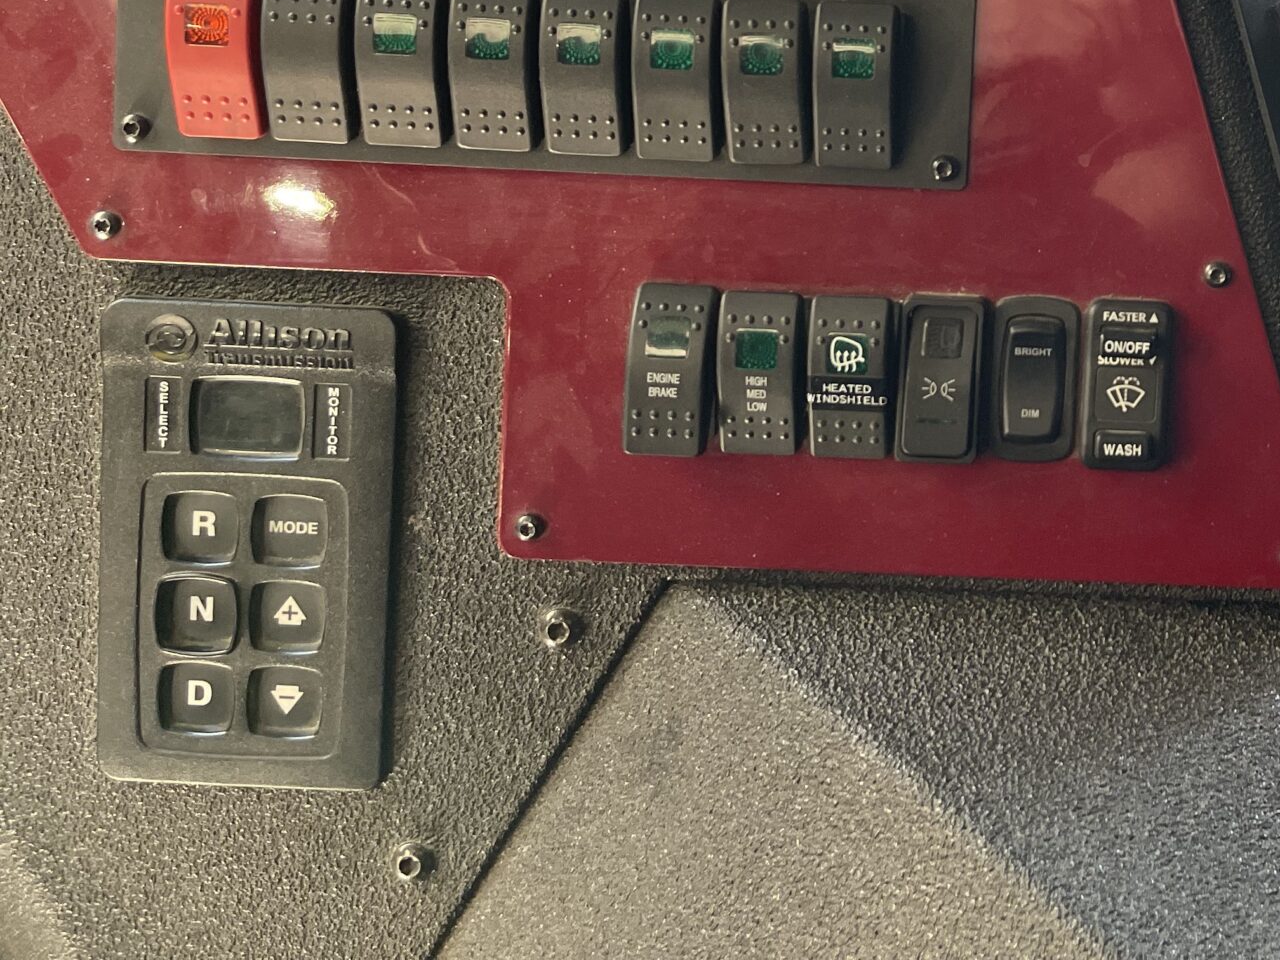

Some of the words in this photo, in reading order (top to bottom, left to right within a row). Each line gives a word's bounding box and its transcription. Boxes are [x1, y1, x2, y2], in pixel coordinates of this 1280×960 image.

[1102, 311, 1146, 323] FASTER
[206, 317, 353, 352] Allison
[1014, 346, 1053, 357] BRIGHT
[1103, 340, 1150, 355] ON/OFF
[203, 348, 355, 371] Transmission
[646, 372, 681, 385] ENGINE
[745, 375, 768, 387] HIGH
[648, 386, 678, 399] BRAKE
[746, 388, 767, 399] MED
[822, 383, 872, 394] HEATED
[807, 392, 887, 406] WINDSHIELD
[746, 401, 767, 413] LOW
[1021, 408, 1040, 419] DIM
[157, 380, 169, 449] SELECT
[326, 386, 340, 456] MONITOR
[1103, 443, 1142, 457] WASH
[191, 509, 217, 537] R
[268, 520, 319, 535] MODE
[189, 595, 214, 622] N
[186, 679, 213, 706] D
